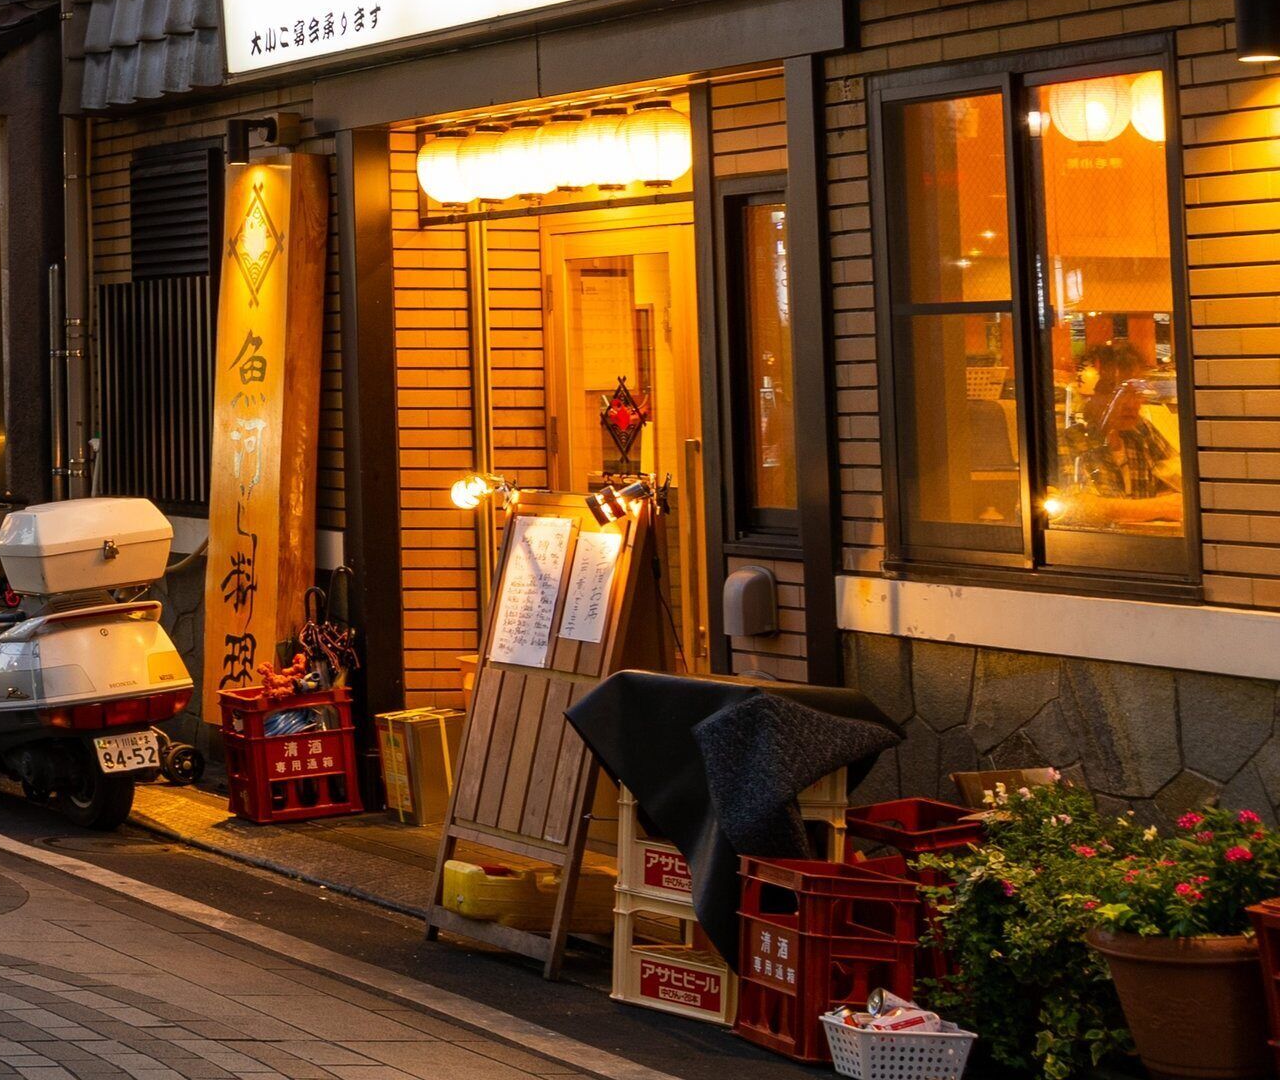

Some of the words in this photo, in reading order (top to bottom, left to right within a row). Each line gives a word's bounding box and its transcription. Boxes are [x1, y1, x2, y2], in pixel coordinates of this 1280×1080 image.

[103, 746, 158, 769] 84-52
[284, 739, 323, 758] 清酒
[275, 756, 334, 773] 専用通箱
[645, 852, 691, 875] アサヒ
[760, 930, 789, 960] 清酒
[642, 963, 719, 994] アサヒビール
[752, 955, 796, 985] 専用通箱
